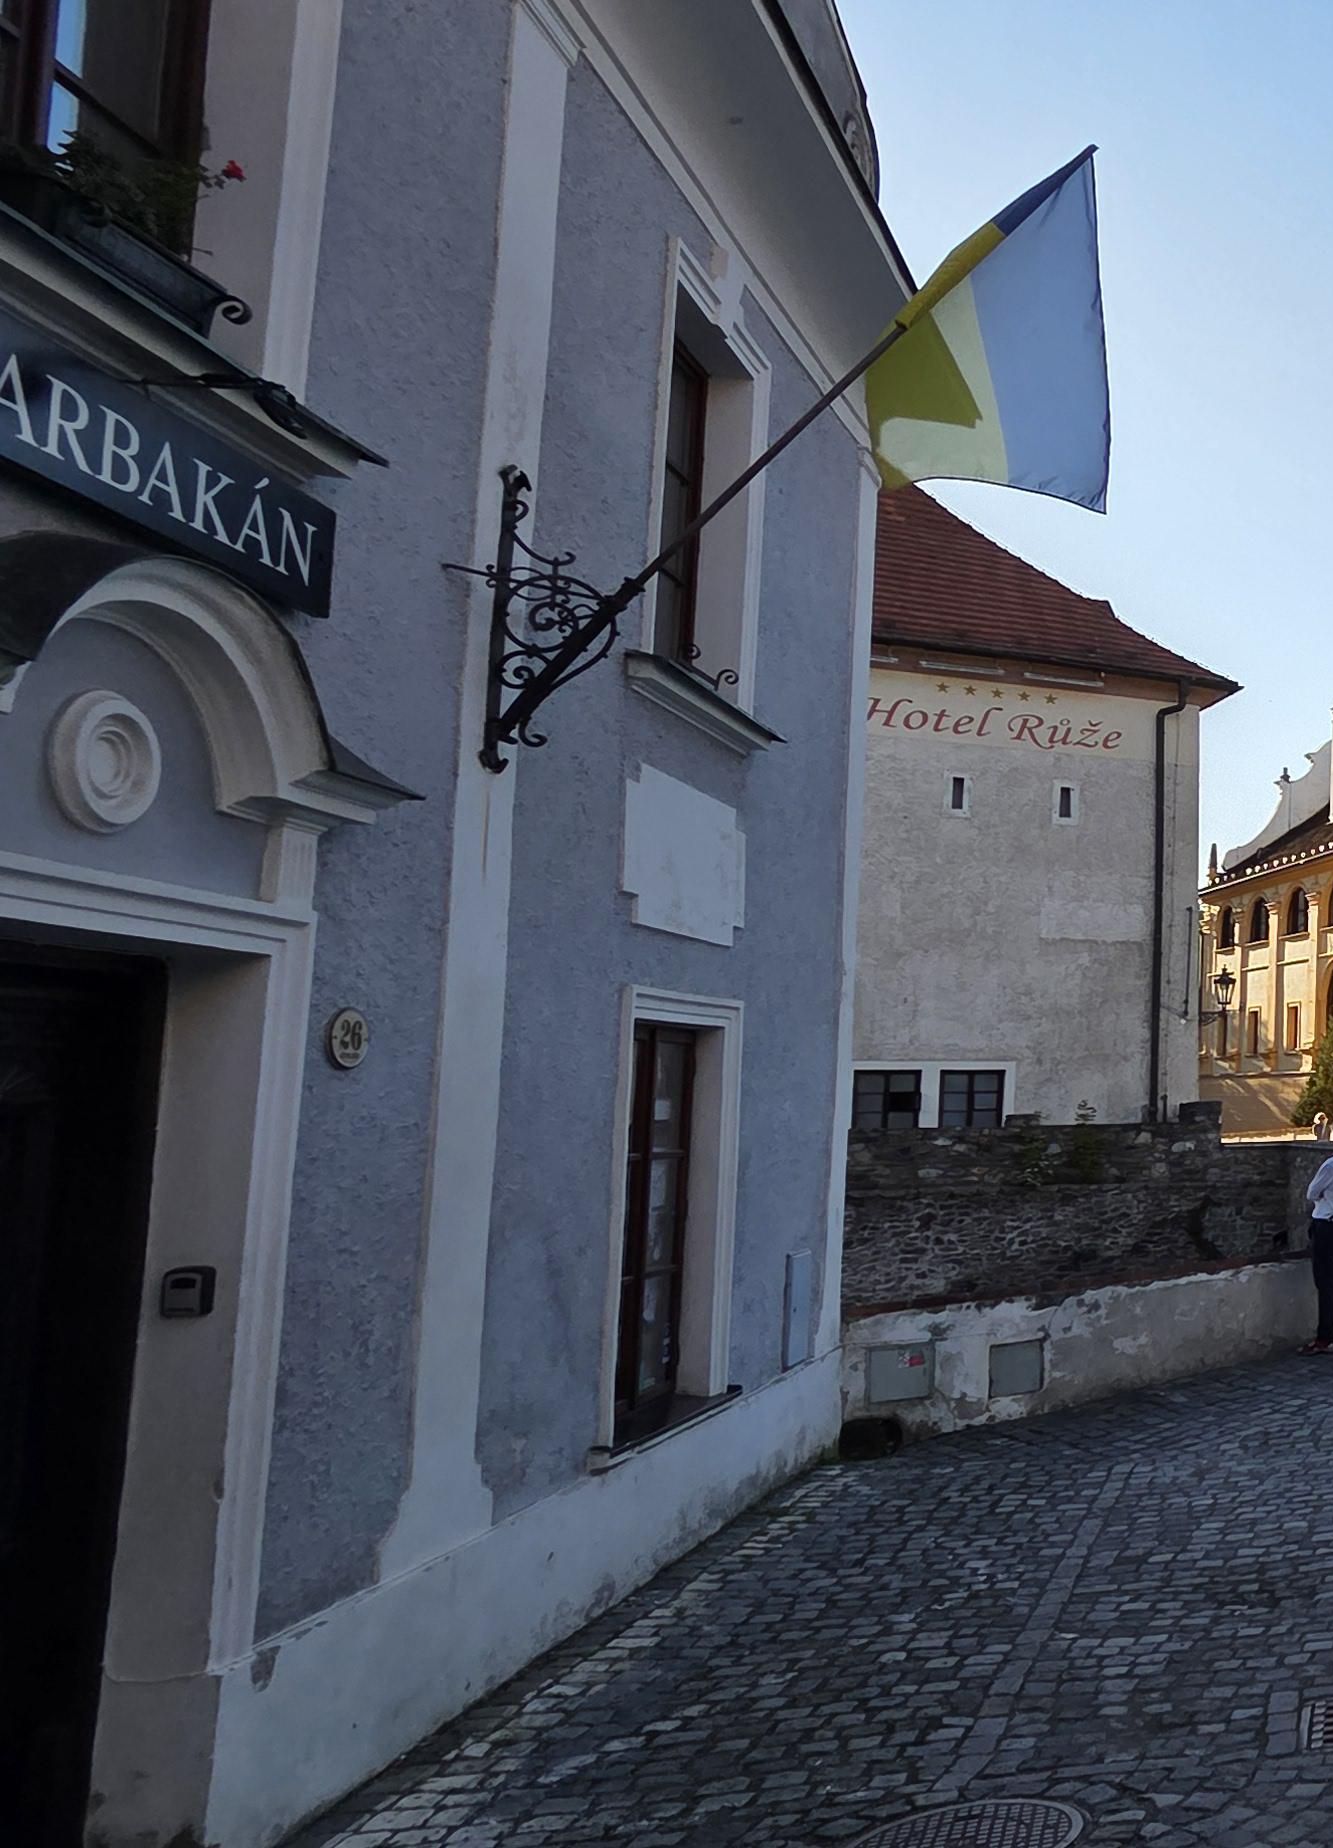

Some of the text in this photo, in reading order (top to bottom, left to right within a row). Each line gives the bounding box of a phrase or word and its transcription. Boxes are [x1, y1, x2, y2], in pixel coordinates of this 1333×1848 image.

[867, 697, 1122, 750] Hotel Růže
[340, 1019, 363, 1051] 26
